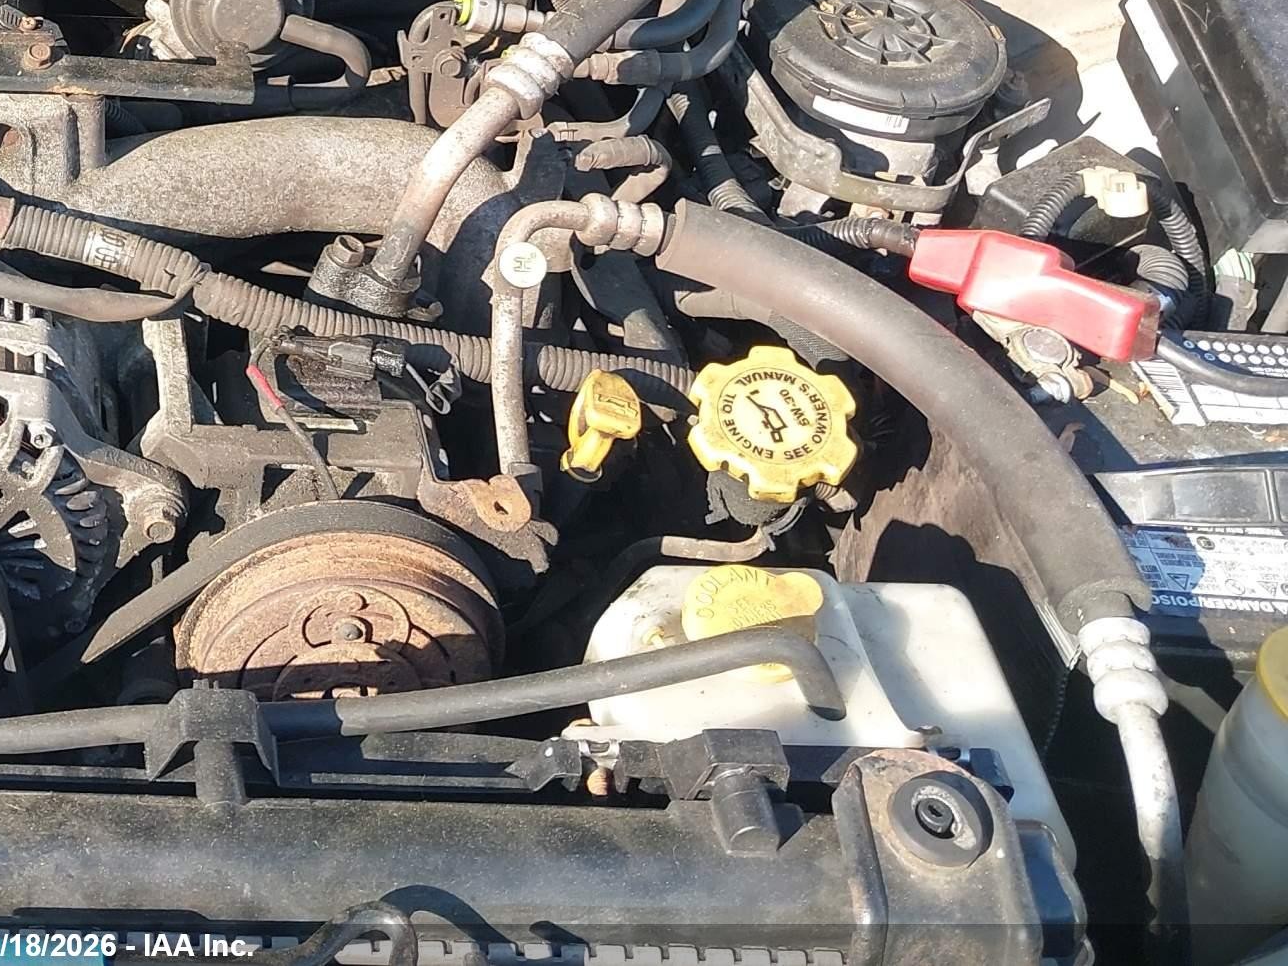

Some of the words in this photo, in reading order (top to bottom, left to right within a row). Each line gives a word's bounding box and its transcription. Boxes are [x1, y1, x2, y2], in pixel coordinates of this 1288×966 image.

[735, 371, 797, 386] MANUAL
[723, 393, 737, 414] OIL
[779, 389, 811, 427] 5W-30
[799, 383, 829, 444] OWNER'S
[724, 419, 774, 459] ENGINE
[783, 443, 813, 460] SEE
[695, 567, 777, 619] COOLANT
[1152, 594, 1275, 613] DANGER/POISO
